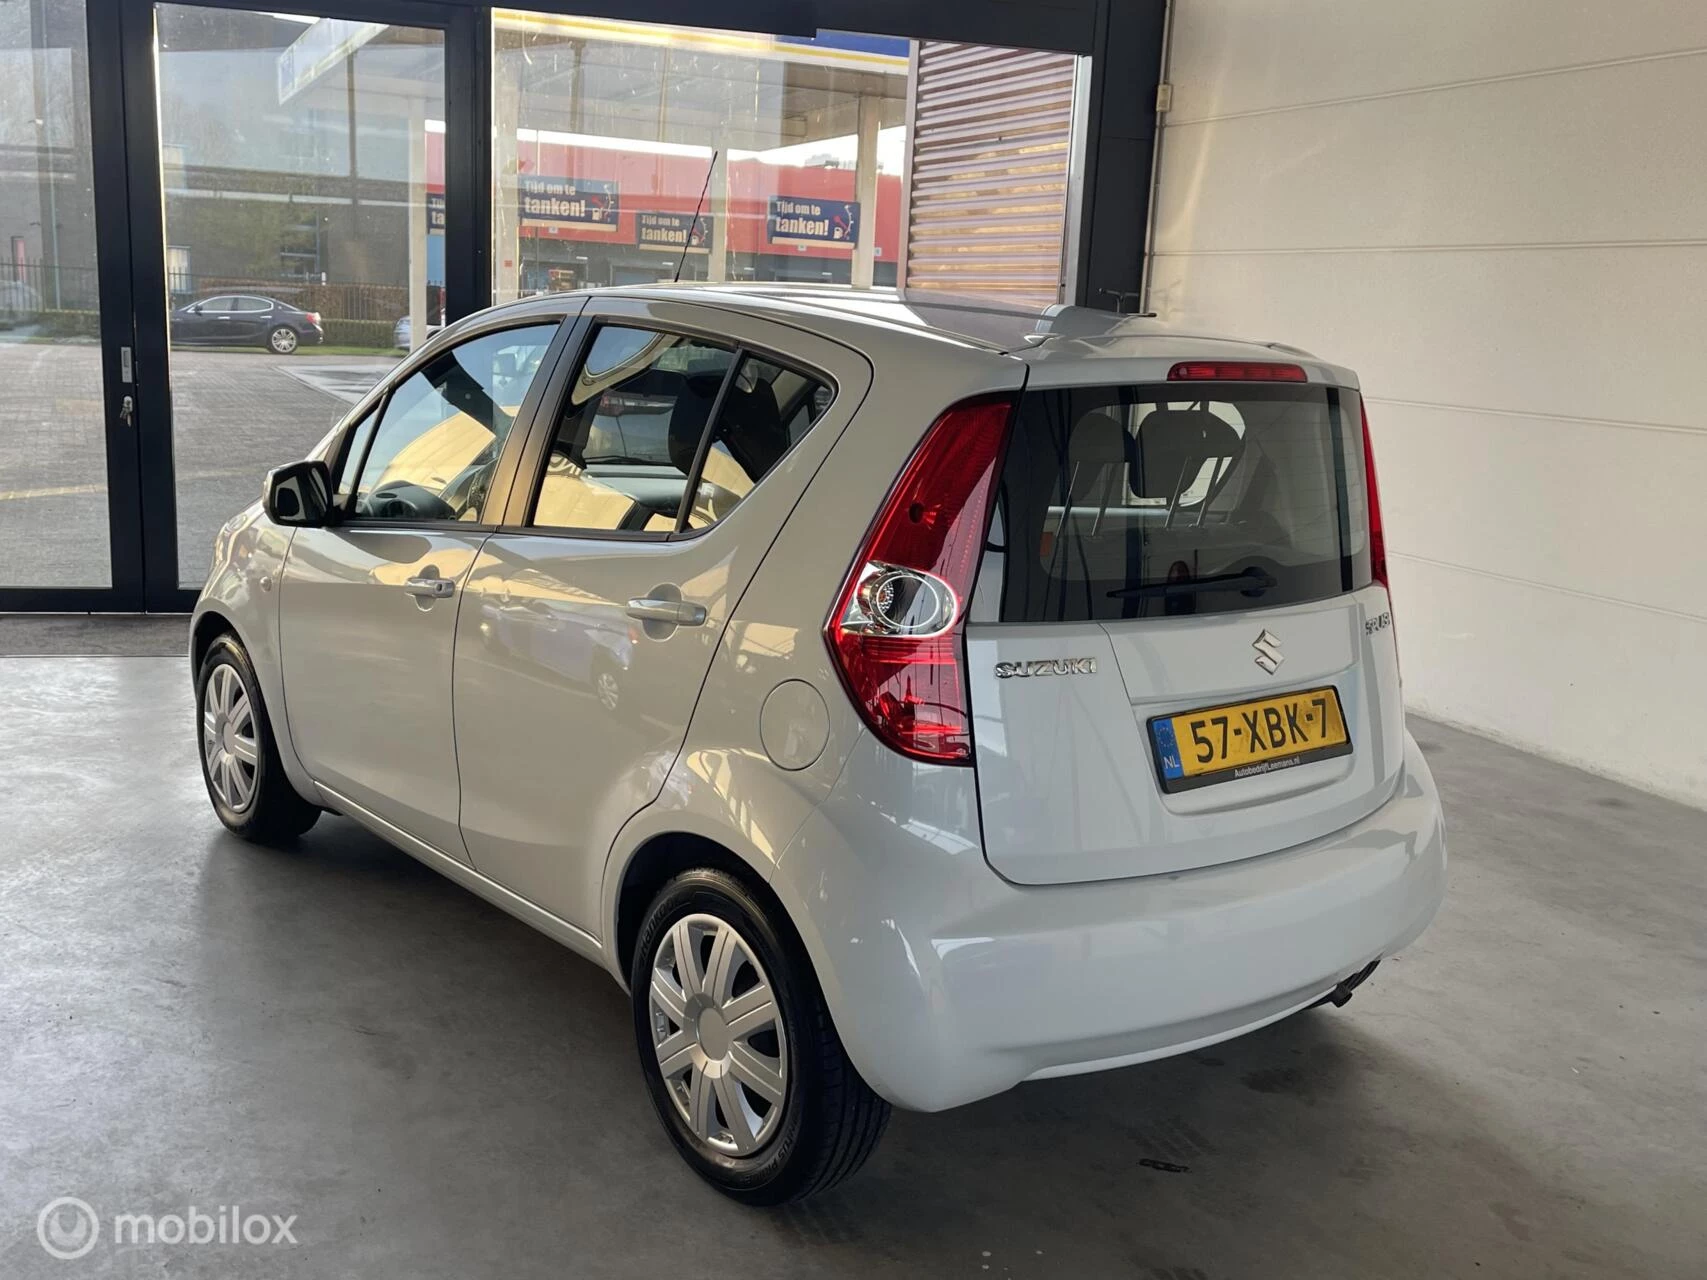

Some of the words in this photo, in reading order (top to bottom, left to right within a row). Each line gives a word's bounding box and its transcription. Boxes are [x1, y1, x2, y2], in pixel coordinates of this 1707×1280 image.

[525, 180, 545, 194] Tijd
[546, 184, 564, 195] om
[565, 184, 577, 196] te
[525, 197, 586, 217] tanken!
[776, 201, 794, 214] Tijd
[795, 204, 810, 215] om
[811, 204, 821, 216] te
[658, 217, 671, 226] om
[776, 216, 830, 236] tanken!
[641, 227, 687, 243] tanken!
[995, 657, 1097, 679] SUZUKI
[1190, 697, 1327, 764] 57-XBK-7
[1163, 755, 1180, 769] NL
